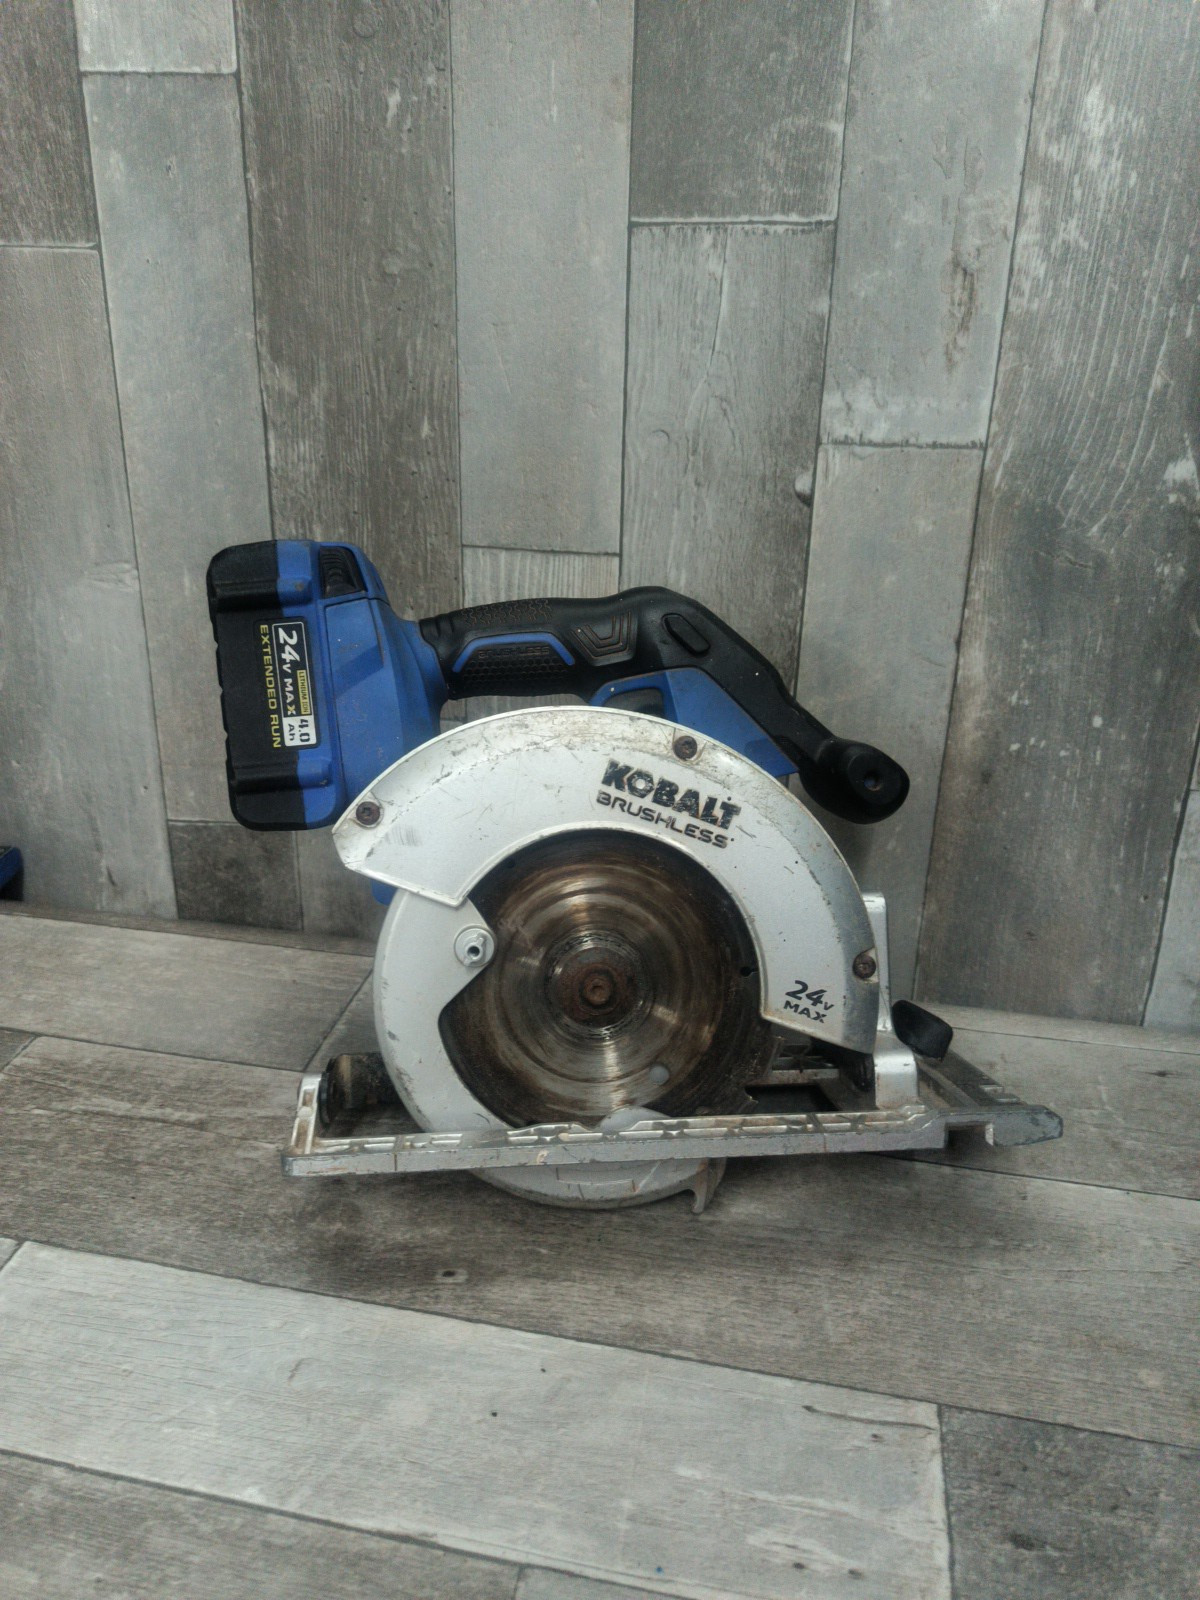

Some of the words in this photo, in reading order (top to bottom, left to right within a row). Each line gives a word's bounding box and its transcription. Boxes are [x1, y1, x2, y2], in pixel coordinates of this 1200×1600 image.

[260, 624, 278, 710] EXTENDED
[270, 714, 282, 748] RUN
[283, 678, 297, 716] MAX
[288, 723, 296, 741] Ah
[298, 718, 311, 743] 4.0
[601, 758, 742, 830] KOBALT
[596, 790, 729, 849] BRUSHLESS
[783, 1000, 827, 1024] MAX
